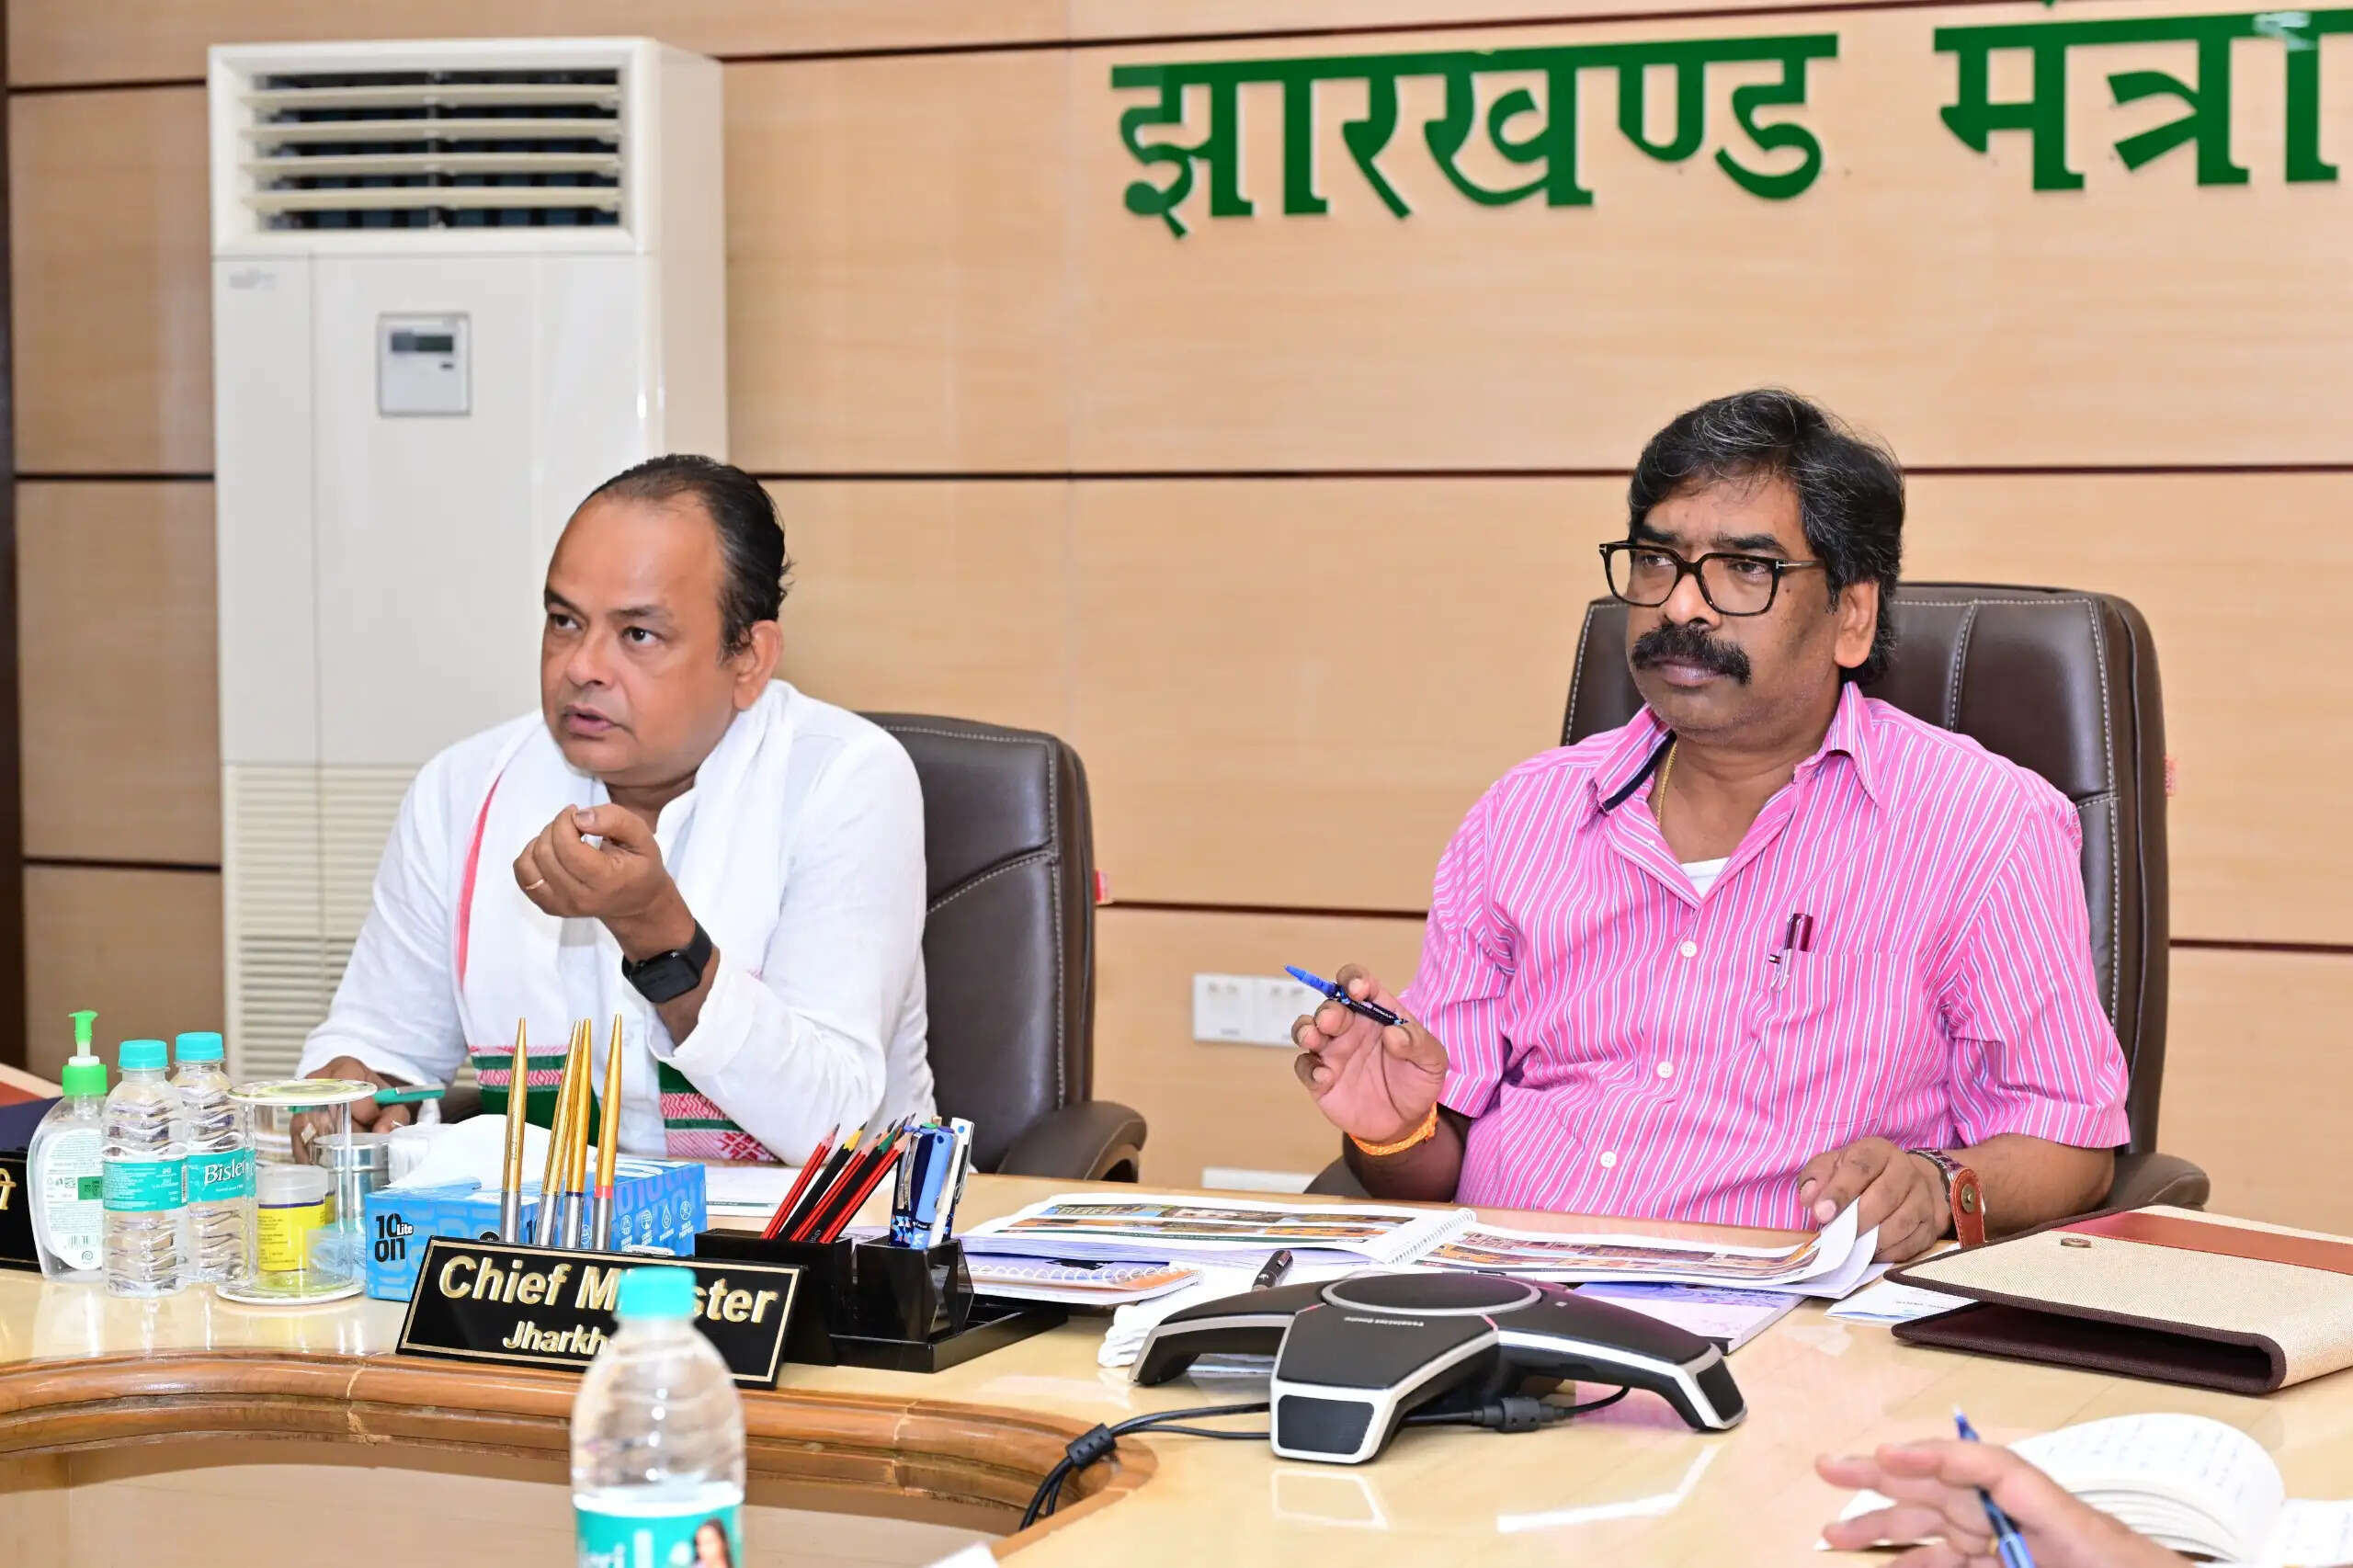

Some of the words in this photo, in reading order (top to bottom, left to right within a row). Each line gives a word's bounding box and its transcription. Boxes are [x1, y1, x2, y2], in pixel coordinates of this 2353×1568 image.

[1112, 34, 1839, 239] झारखण्ड
[1934, 0, 2353, 191] मत्रा
[376, 1213, 403, 1239] 10
[397, 1223, 413, 1236] Lite
[439, 1255, 573, 1306] Chief
[574, 1265, 779, 1324] Mster
[503, 1321, 608, 1355] Jharkh
